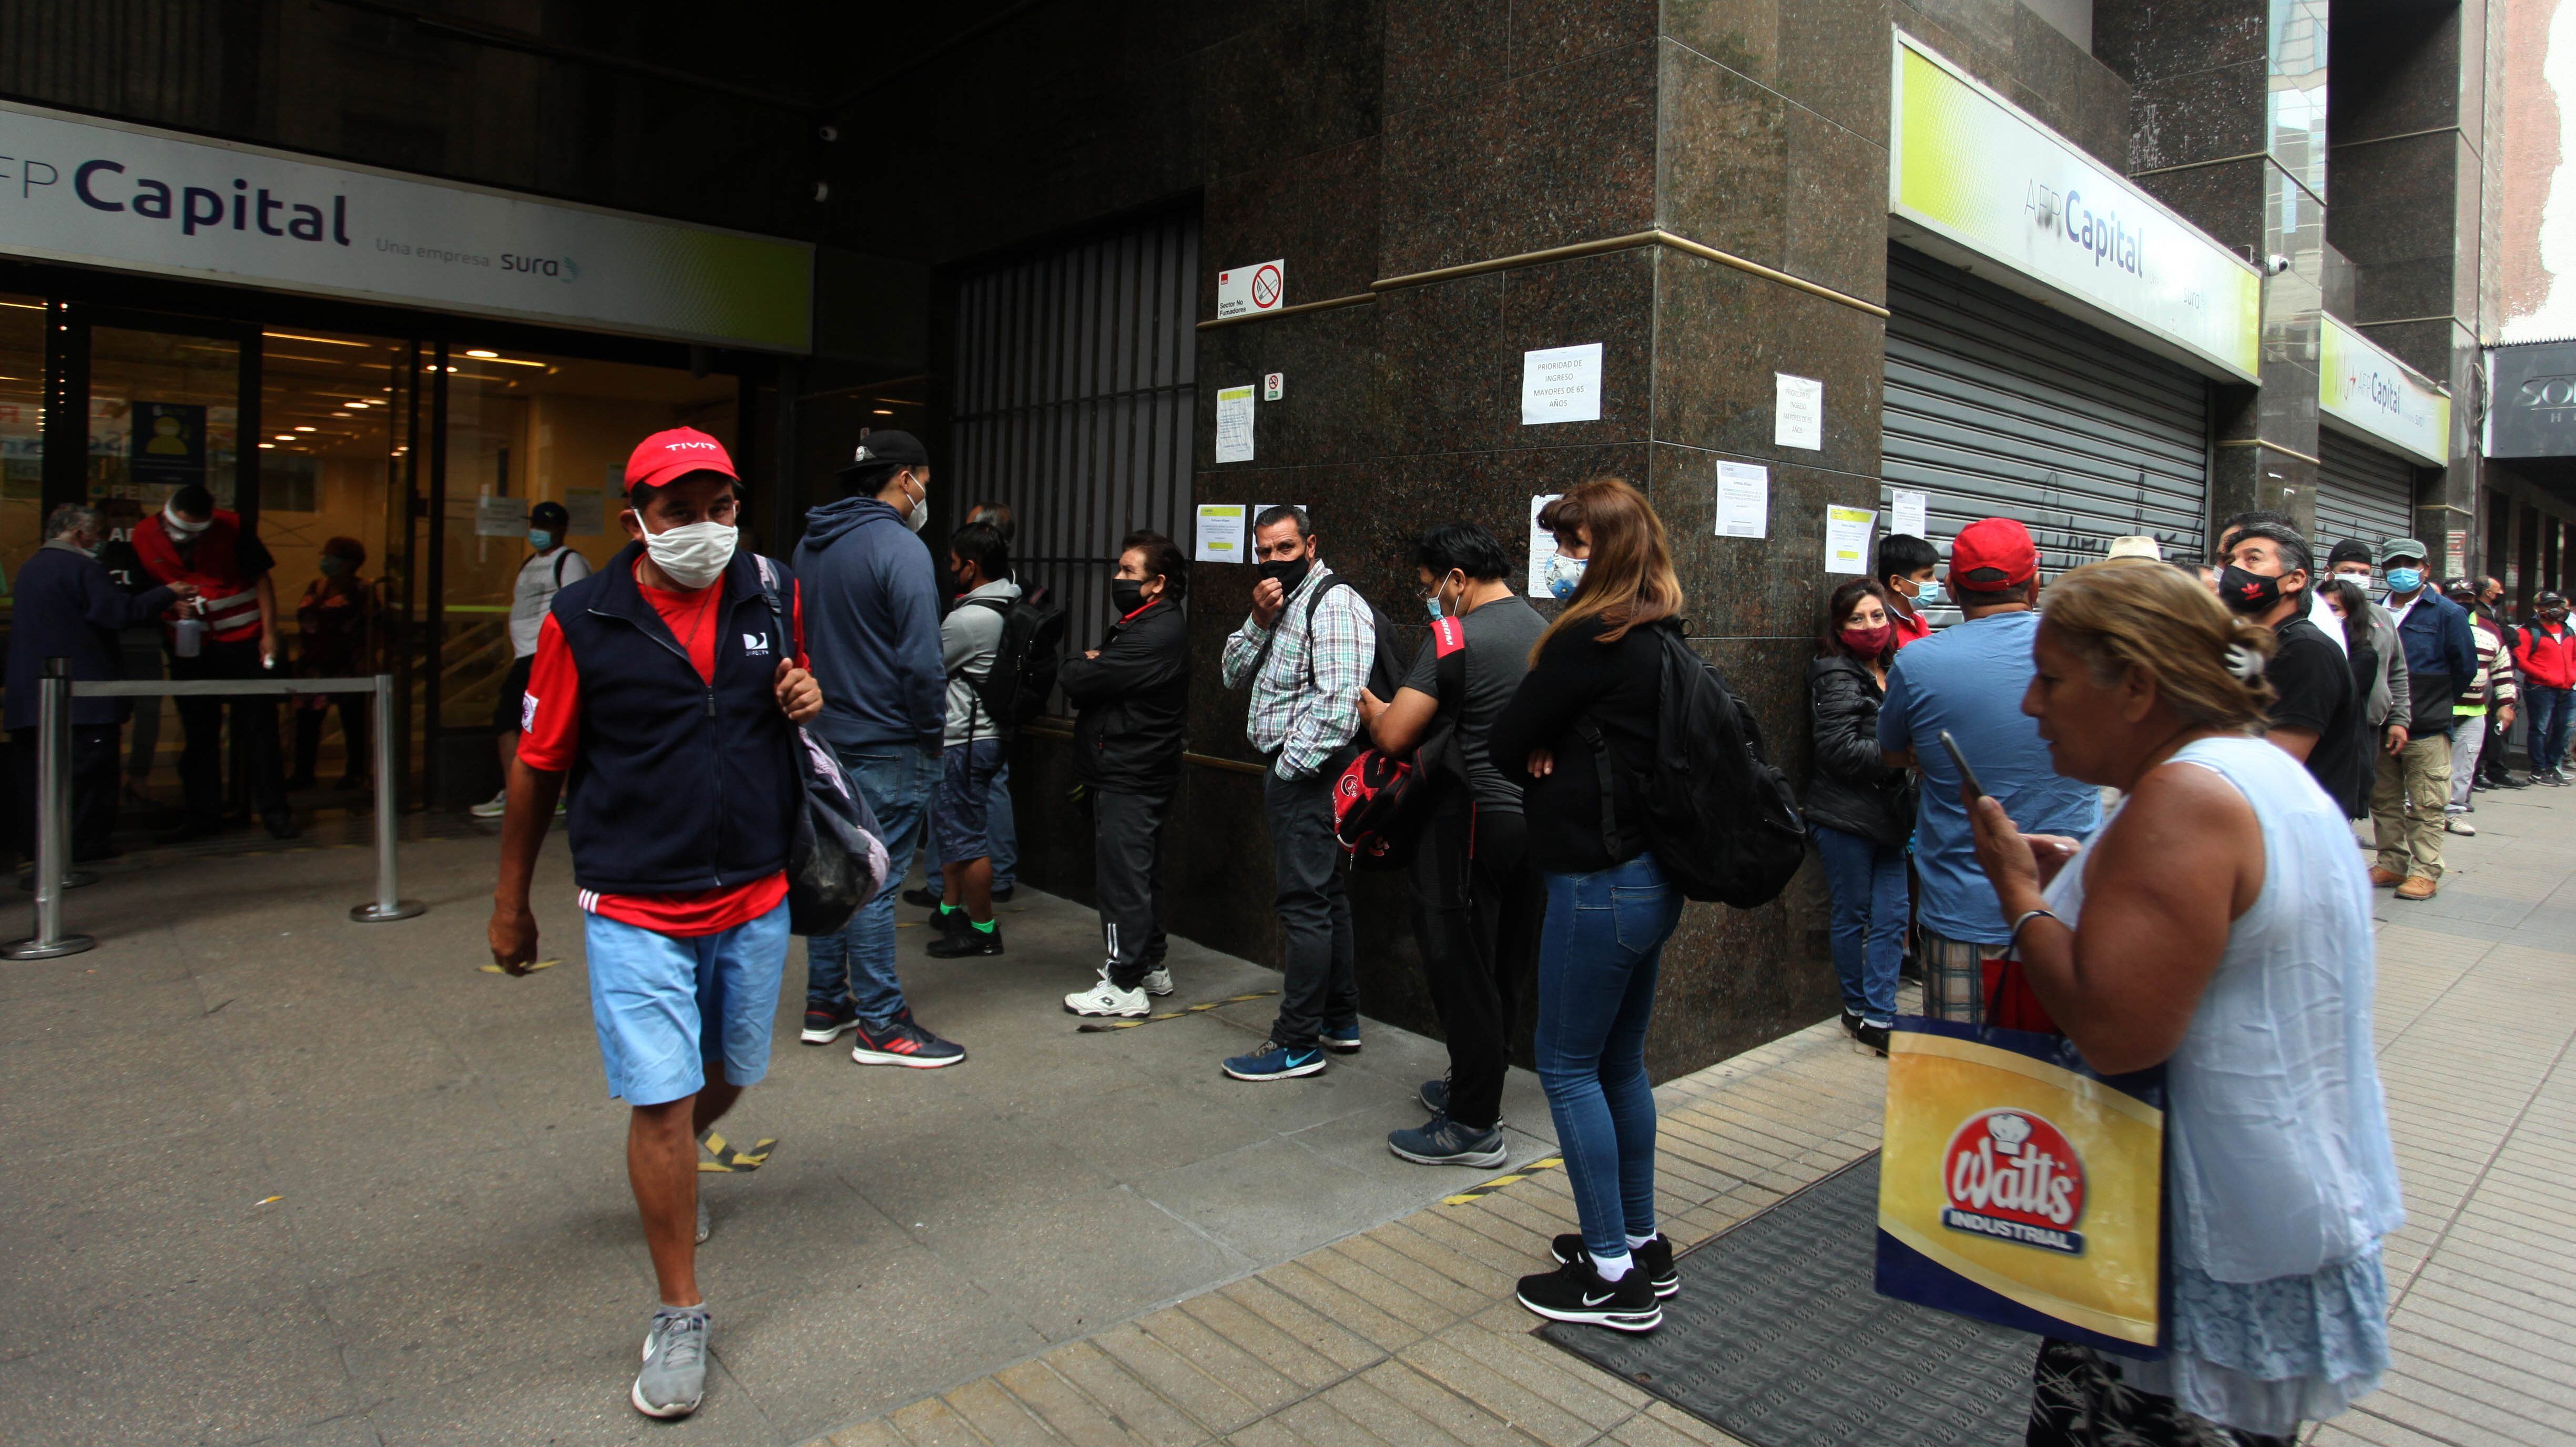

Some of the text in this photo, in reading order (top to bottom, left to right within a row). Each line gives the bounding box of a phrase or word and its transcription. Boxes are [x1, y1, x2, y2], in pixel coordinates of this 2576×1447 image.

[74, 159, 351, 247] Capital
[2024, 178, 2143, 279] AFP Capital
[375, 237, 559, 277] Una empresa sura
[2183, 287, 2200, 309] sura
[1219, 307, 1246, 316] Fumadores
[1537, 359, 1582, 371] PRIORIDAD DE
[1545, 373, 1573, 382] INGRESO
[1533, 385, 1584, 397] MAYORES DE 65
[2371, 371, 2400, 414] Capital
[2520, 378, 2576, 406] SO
[1549, 399, 1568, 408] AÑOS
[665, 442, 717, 451] TIVIT
[1949, 1209, 2073, 1250] INDUSTRIAL
